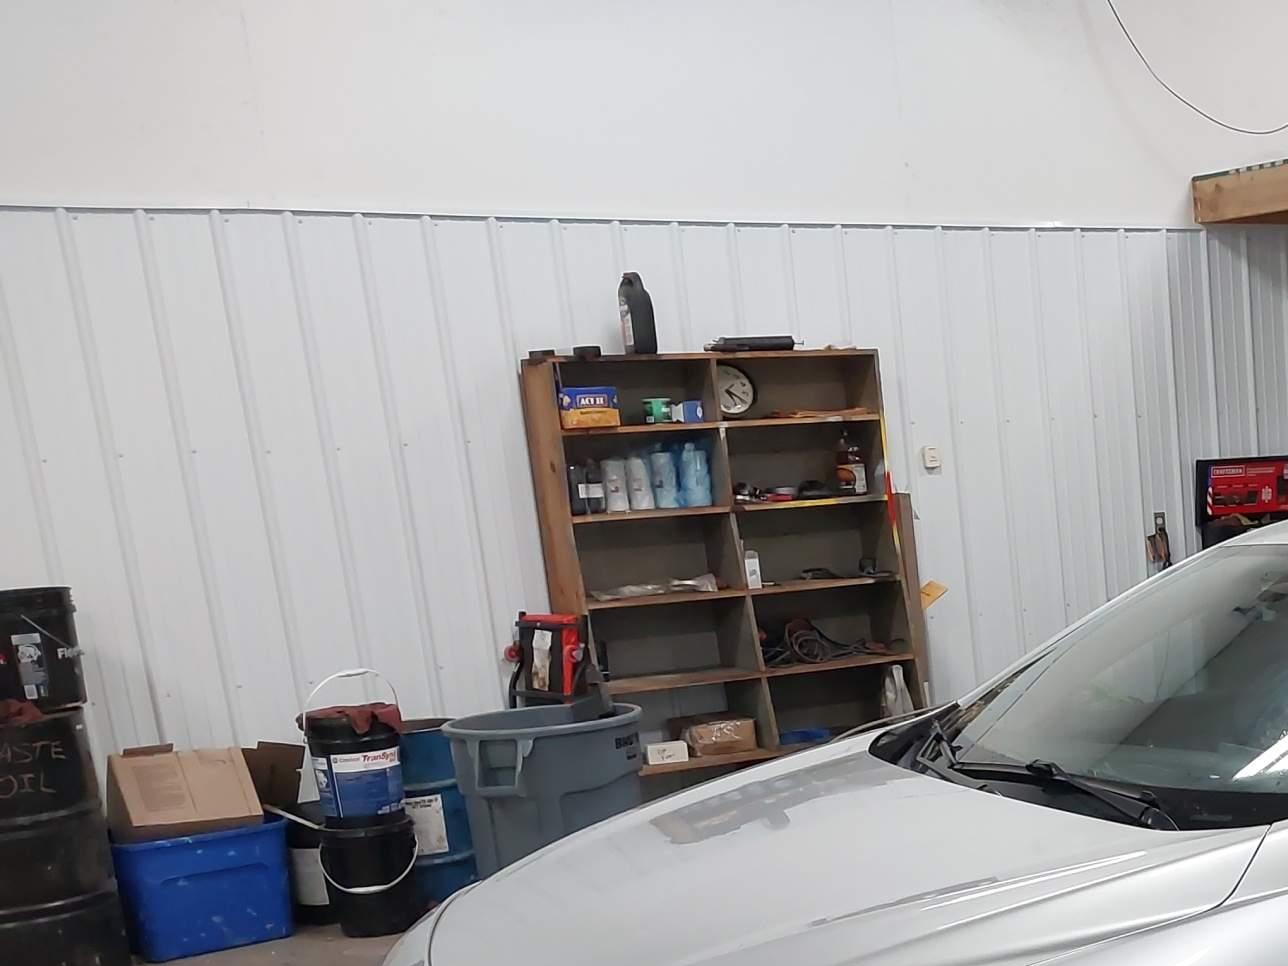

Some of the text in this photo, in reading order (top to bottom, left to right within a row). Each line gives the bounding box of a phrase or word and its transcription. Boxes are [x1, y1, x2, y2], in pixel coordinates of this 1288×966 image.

[580, 397, 594, 405] ACT
[0, 741, 66, 763] ASTE
[0, 768, 57, 799] OIL
